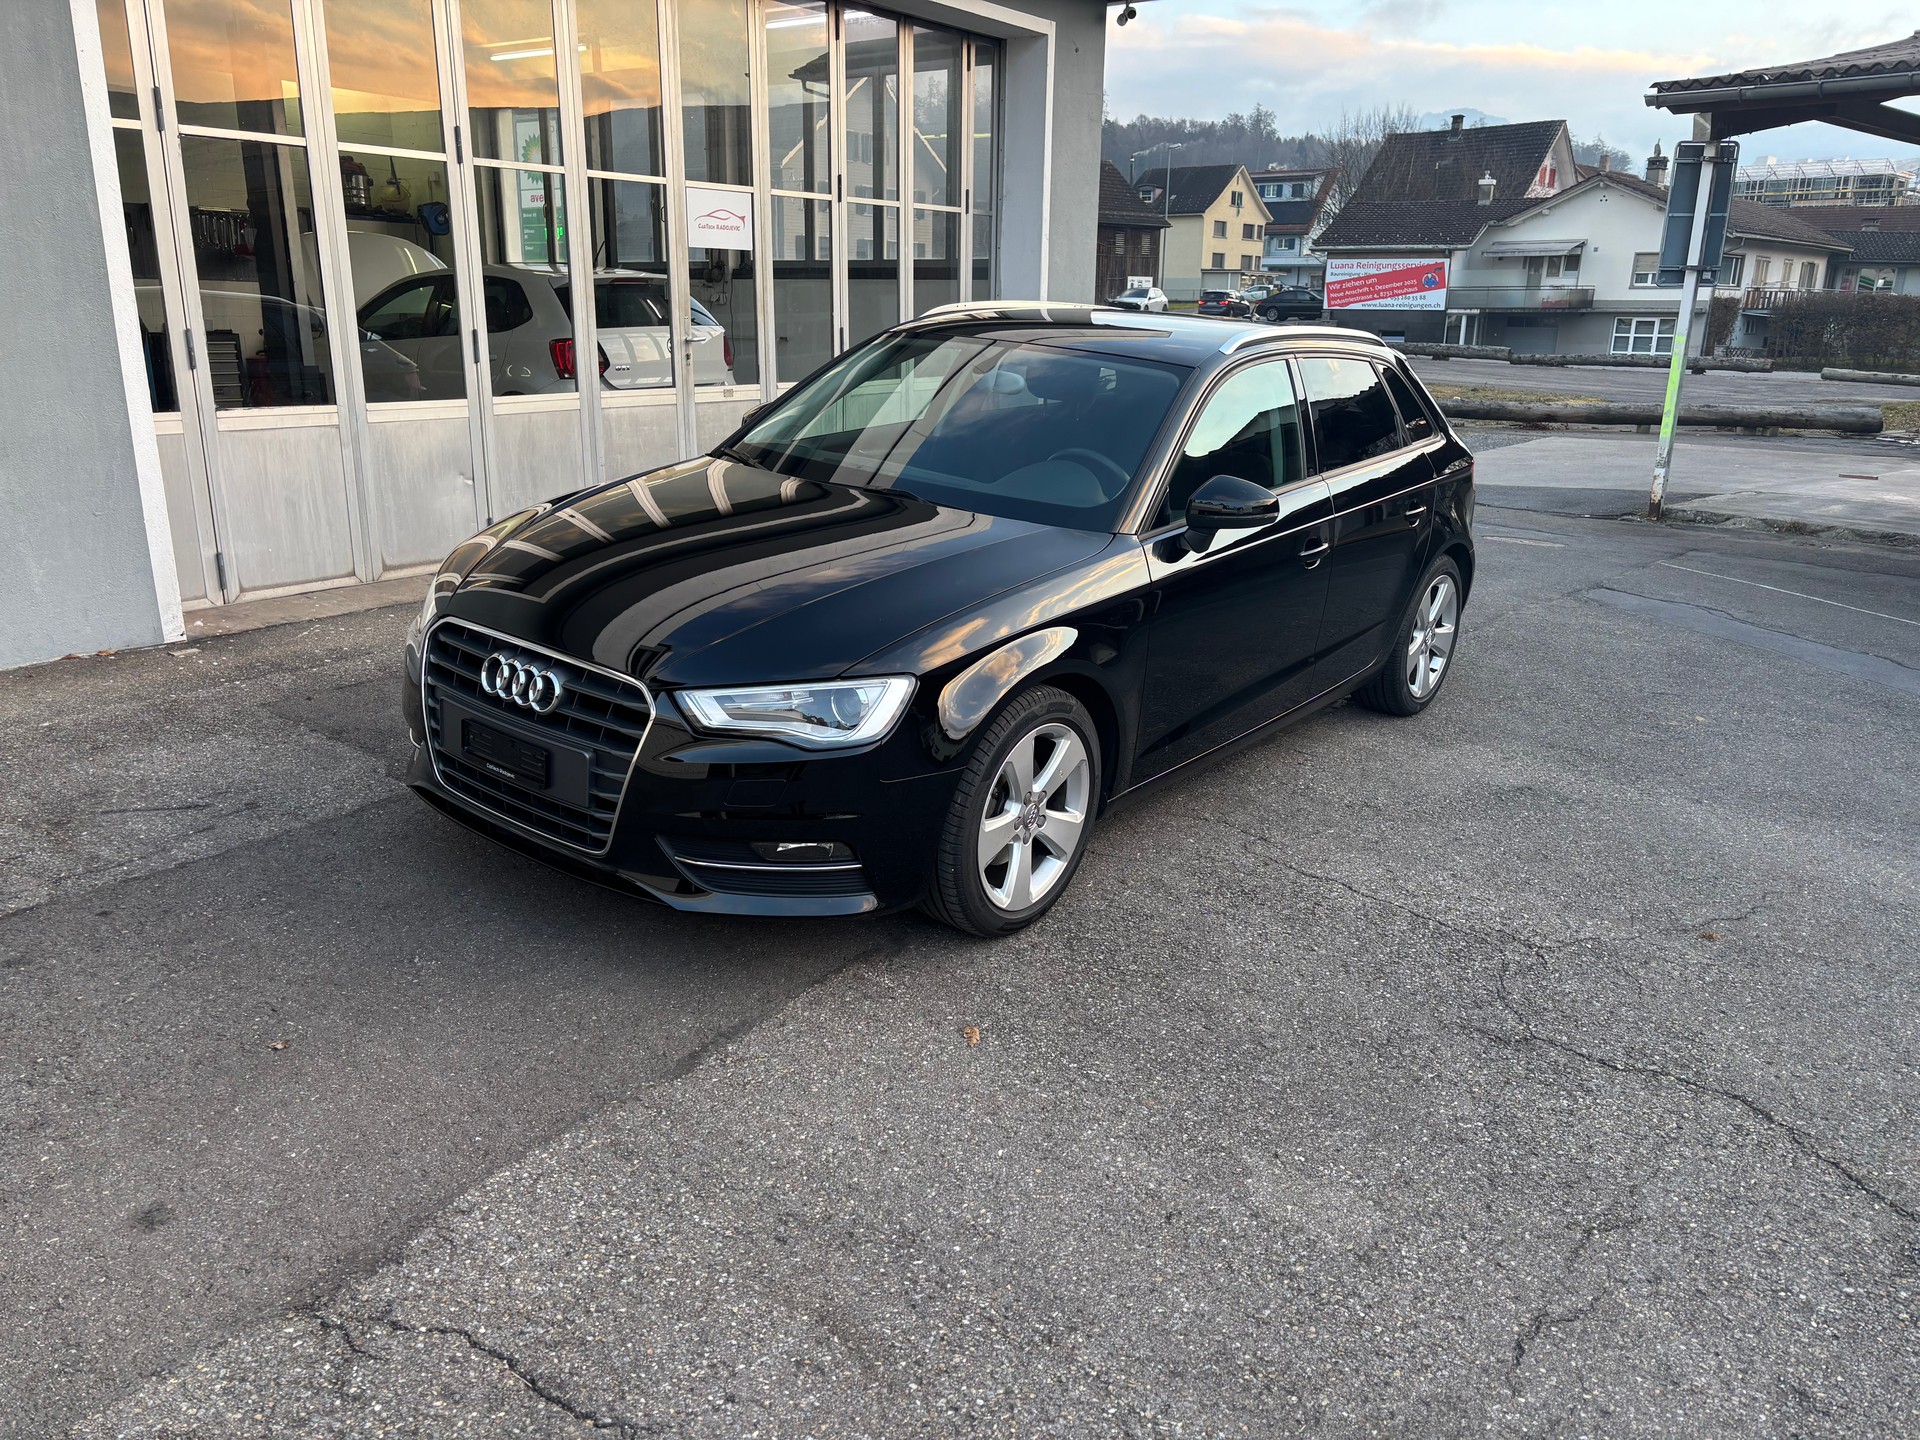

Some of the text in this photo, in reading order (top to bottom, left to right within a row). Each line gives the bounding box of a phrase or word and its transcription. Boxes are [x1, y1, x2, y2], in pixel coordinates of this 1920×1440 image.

[530, 194, 545, 203] ave
[1330, 260, 1430, 272] Luana Reinigungsservic
[1342, 279, 1365, 289] ziehen
[1366, 277, 1378, 285] um
[1345, 286, 1369, 296] Anschrift
[1375, 281, 1403, 291] Dezember
[1330, 294, 1373, 305] Industriestrasse
[1380, 290, 1393, 298] 8732
[1393, 286, 1418, 295] Neuhaus
[1361, 302, 1441, 310] www.luana-reinigungen.ch
